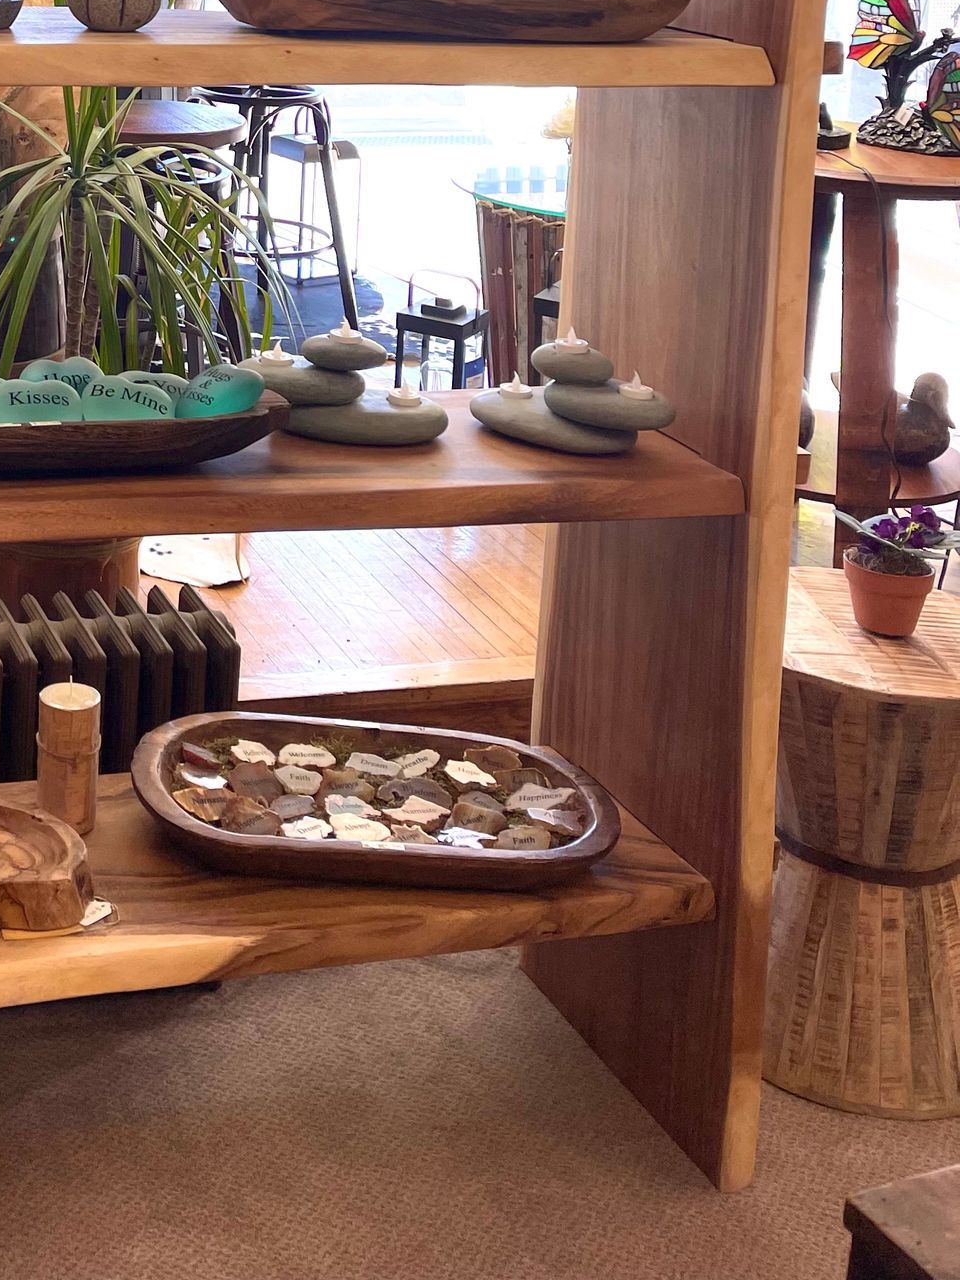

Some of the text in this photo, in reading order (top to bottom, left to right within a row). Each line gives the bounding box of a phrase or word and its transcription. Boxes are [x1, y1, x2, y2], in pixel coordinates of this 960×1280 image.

[9, 391, 70, 407] Kisses
[90, 384, 169, 415] Be Mine
[512, 836, 536, 846] Faith
